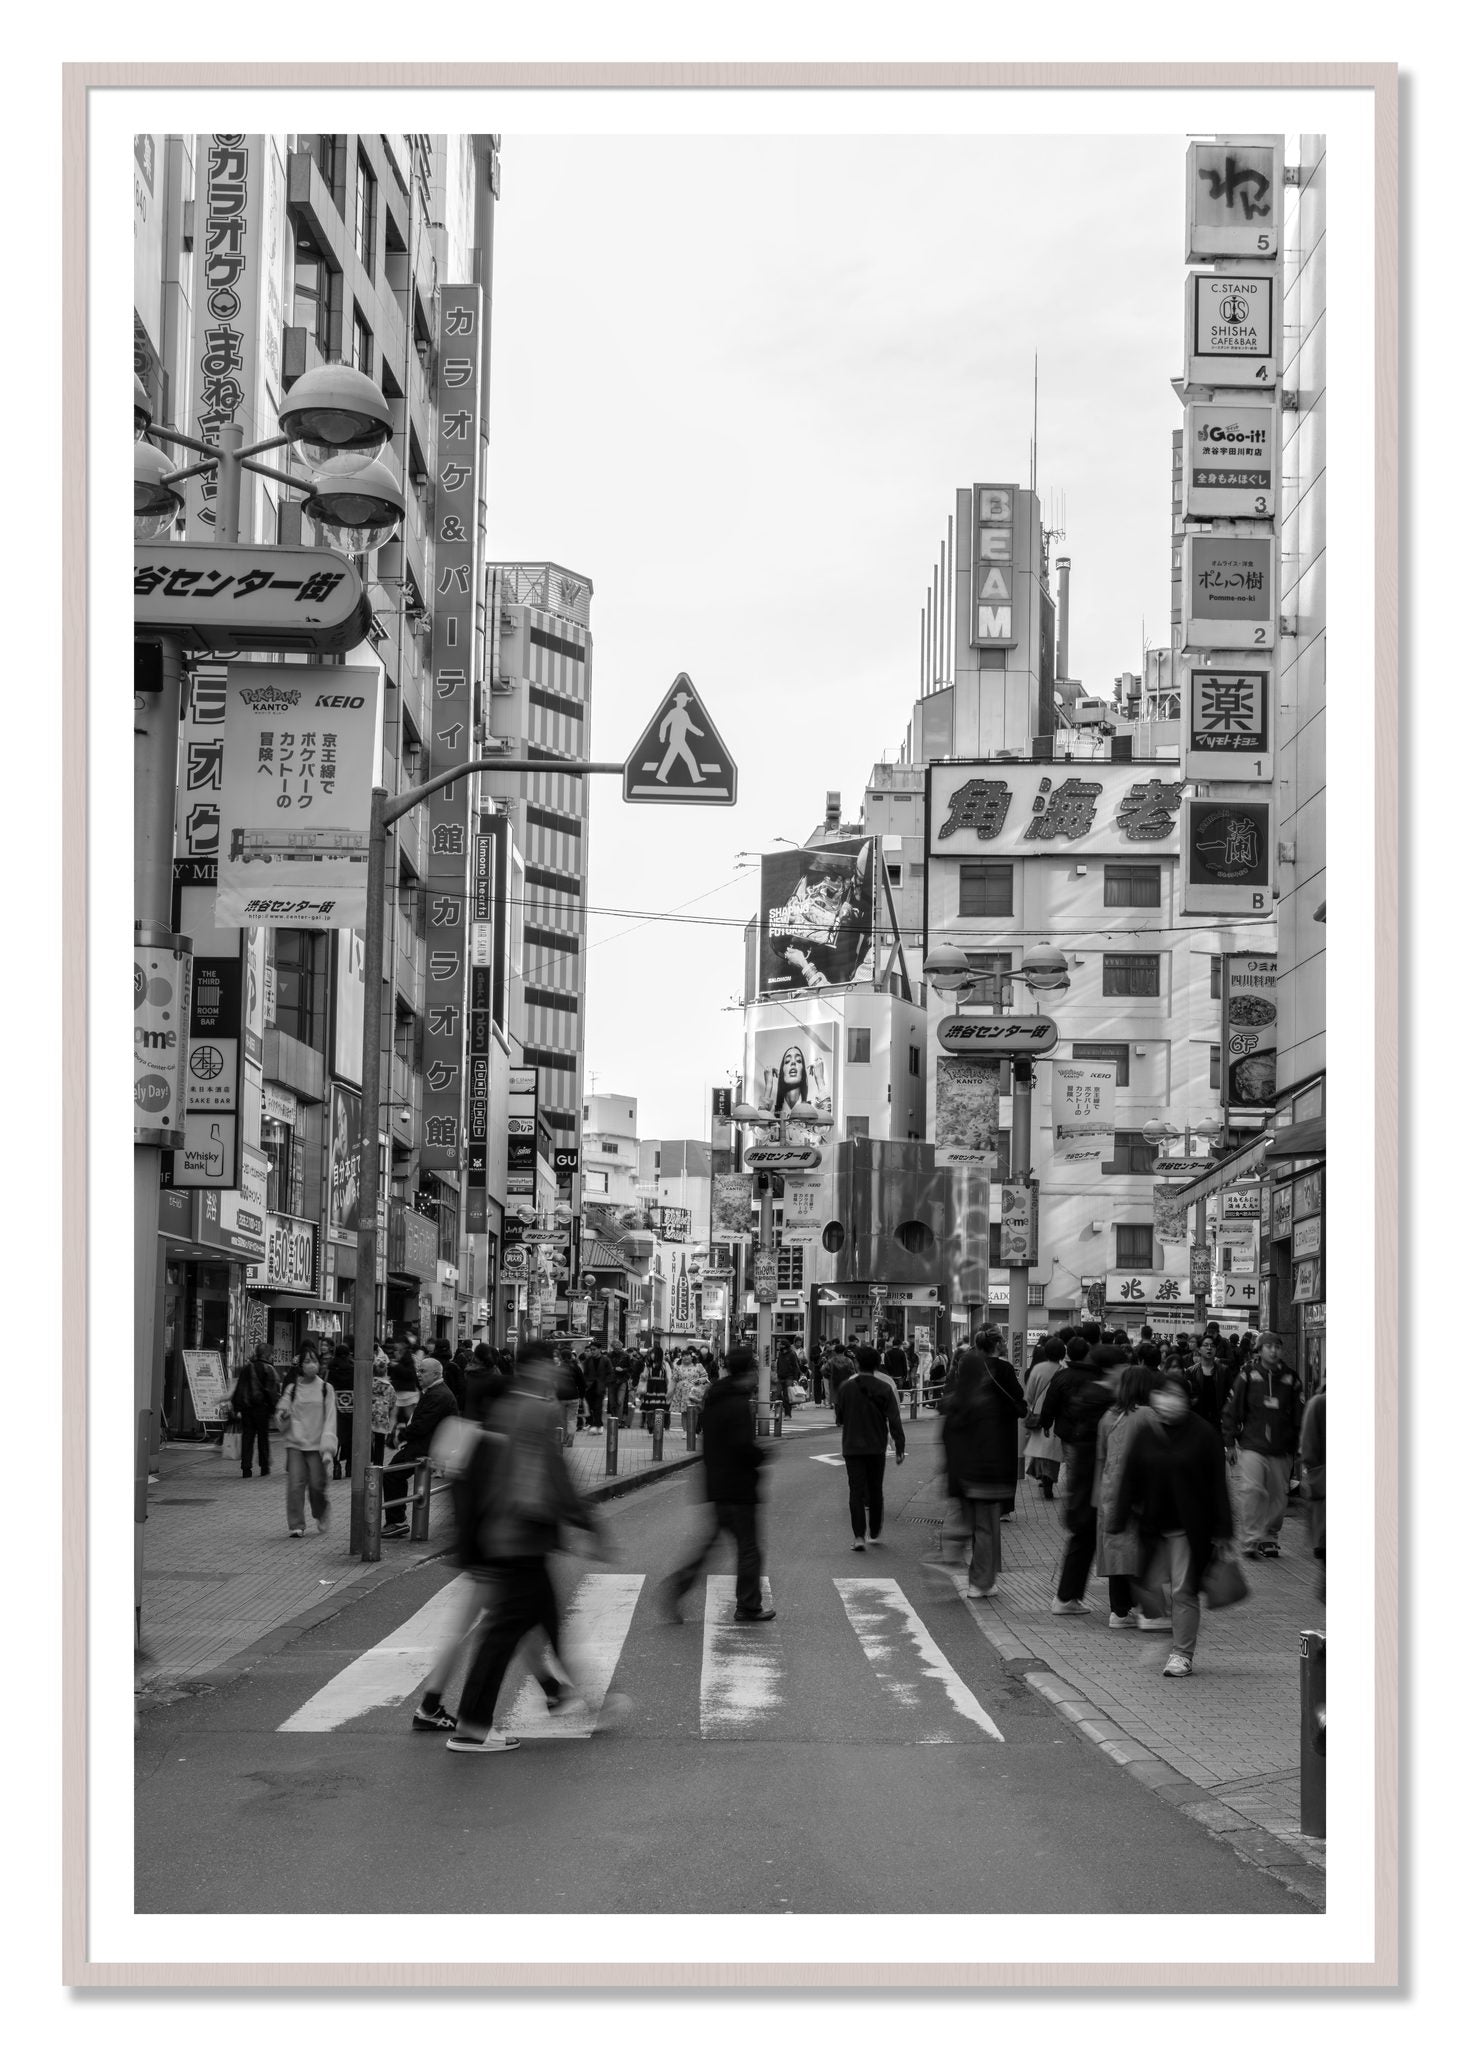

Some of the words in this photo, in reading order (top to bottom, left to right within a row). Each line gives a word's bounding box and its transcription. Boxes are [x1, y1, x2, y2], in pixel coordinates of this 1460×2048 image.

[206, 144, 248, 289] カラオケ
[1257, 234, 1270, 250] 5
[1211, 283, 1258, 294] C.STAND
[1211, 325, 1258, 337] SHISHA
[1211, 337, 1258, 346] CAFE&BAR
[1255, 365, 1269, 381] 4
[1202, 446, 1263, 456] 渋谷宇田川町店
[1197, 472, 1267, 485] 全身もみほぐし
[1254, 496, 1267, 514] 3
[978, 489, 1013, 638] BEAM
[134, 565, 346, 603] 谷センター街
[1198, 569, 1265, 590] ポムの樹
[1209, 594, 1256, 602] Pomme-no-ki
[1254, 628, 1266, 643] 2
[253, 703, 289, 712] KANTO
[315, 695, 365, 709] KEIO
[1201, 678, 1254, 731] 薬
[1195, 733, 1259, 748] マツモトキヨシ
[257, 731, 274, 776] 冒険へ
[277, 732, 295, 808] カントーの
[320, 733, 338, 794] 京王線で
[1253, 760, 1262, 776] 1
[938, 777, 1186, 840] 角海老
[1196, 817, 1259, 868] 一蘭
[479, 839, 488, 876] kimono
[478, 881, 487, 916] hearts
[1252, 893, 1264, 909] B
[244, 900, 336, 914] 渋谷センター街
[201, 970, 217, 978] THE
[1231, 974, 1276, 988] 四川料理
[197, 1007, 220, 1015] ROOM
[200, 1018, 216, 1026] BAR
[944, 1024, 1051, 1039] 渋谷センター街
[1229, 1034, 1259, 1054] 6F
[184, 1151, 219, 1163] Whisky
[557, 1155, 577, 1166] GU
[748, 1151, 812, 1161] 渋谷センター街
[184, 1161, 205, 1170] Bank
[886, 1292, 913, 1300] 田川交番
[1120, 1278, 1182, 1301] 兆楽
[1226, 1284, 1256, 1300] の中
[680, 1277, 688, 1320] BEER
